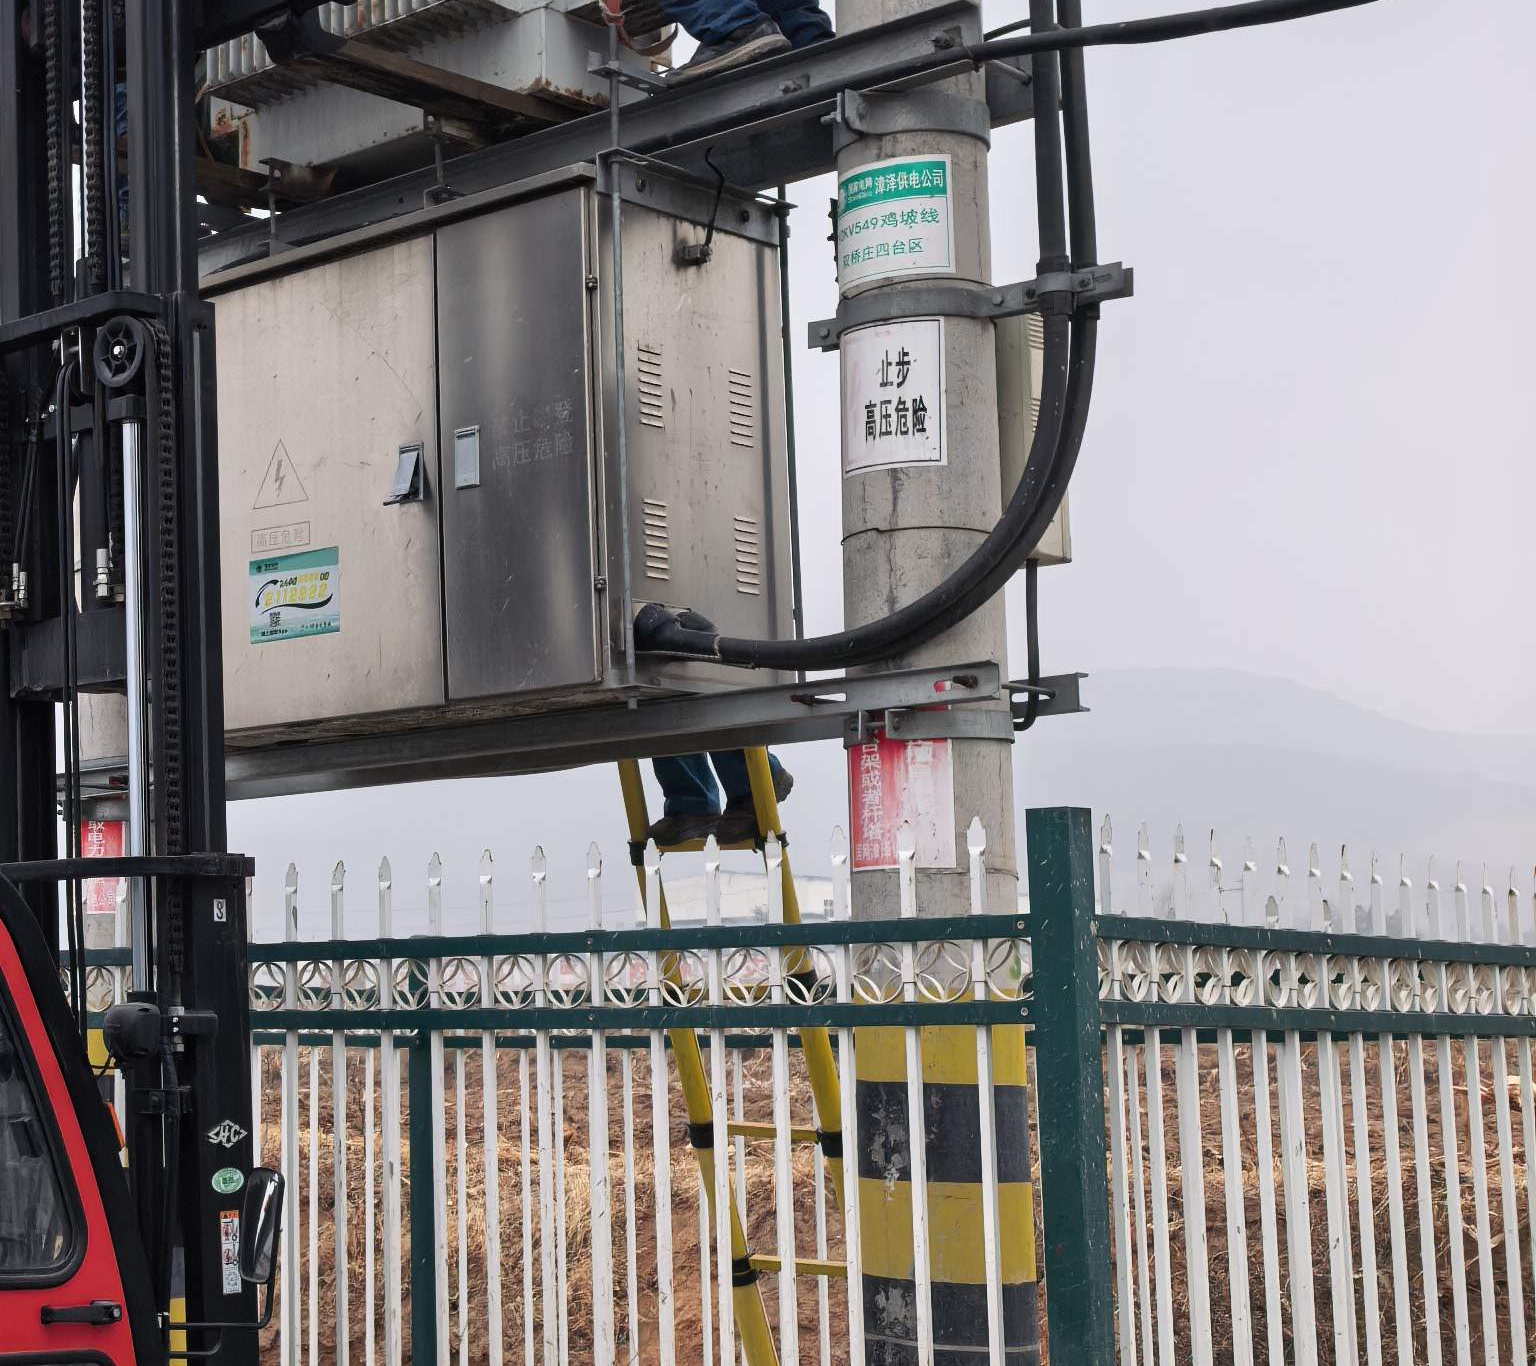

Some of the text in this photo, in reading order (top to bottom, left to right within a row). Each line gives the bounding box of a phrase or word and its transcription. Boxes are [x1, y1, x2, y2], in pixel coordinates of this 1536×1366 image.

[879, 347, 912, 389] 止步
[864, 395, 928, 445] 高压危险
